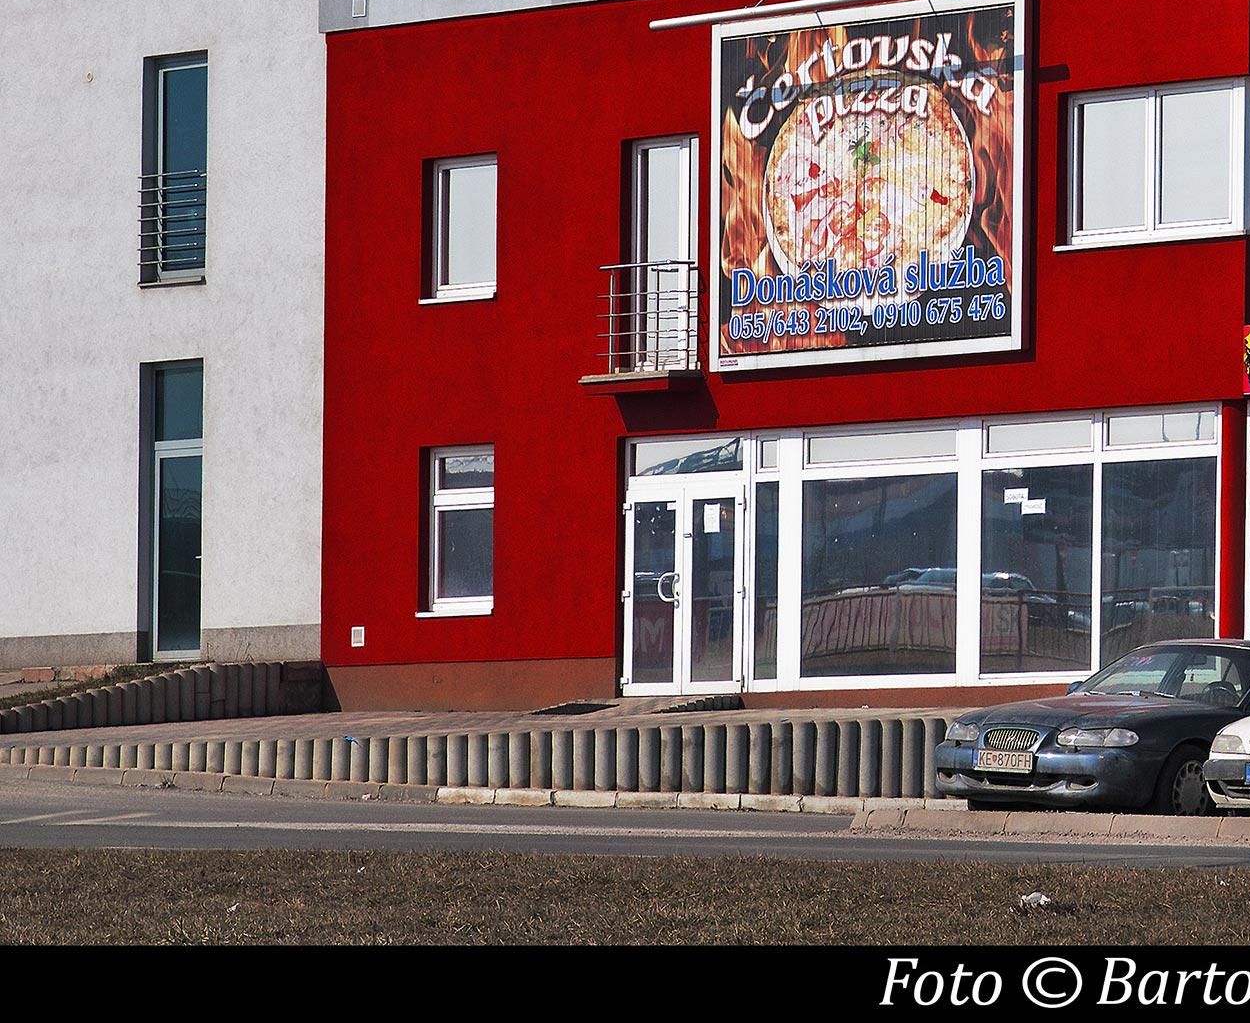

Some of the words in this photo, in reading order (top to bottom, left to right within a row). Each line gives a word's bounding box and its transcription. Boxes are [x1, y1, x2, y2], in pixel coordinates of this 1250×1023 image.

[805, 78, 930, 145] pizza
[731, 255, 896, 307] Donášková
[905, 244, 1006, 293] služba
[729, 308, 810, 344] 055/643
[815, 306, 868, 336] 2102,
[873, 300, 922, 329] 0910
[926, 297, 963, 324] 675
[967, 293, 1007, 321] 476
